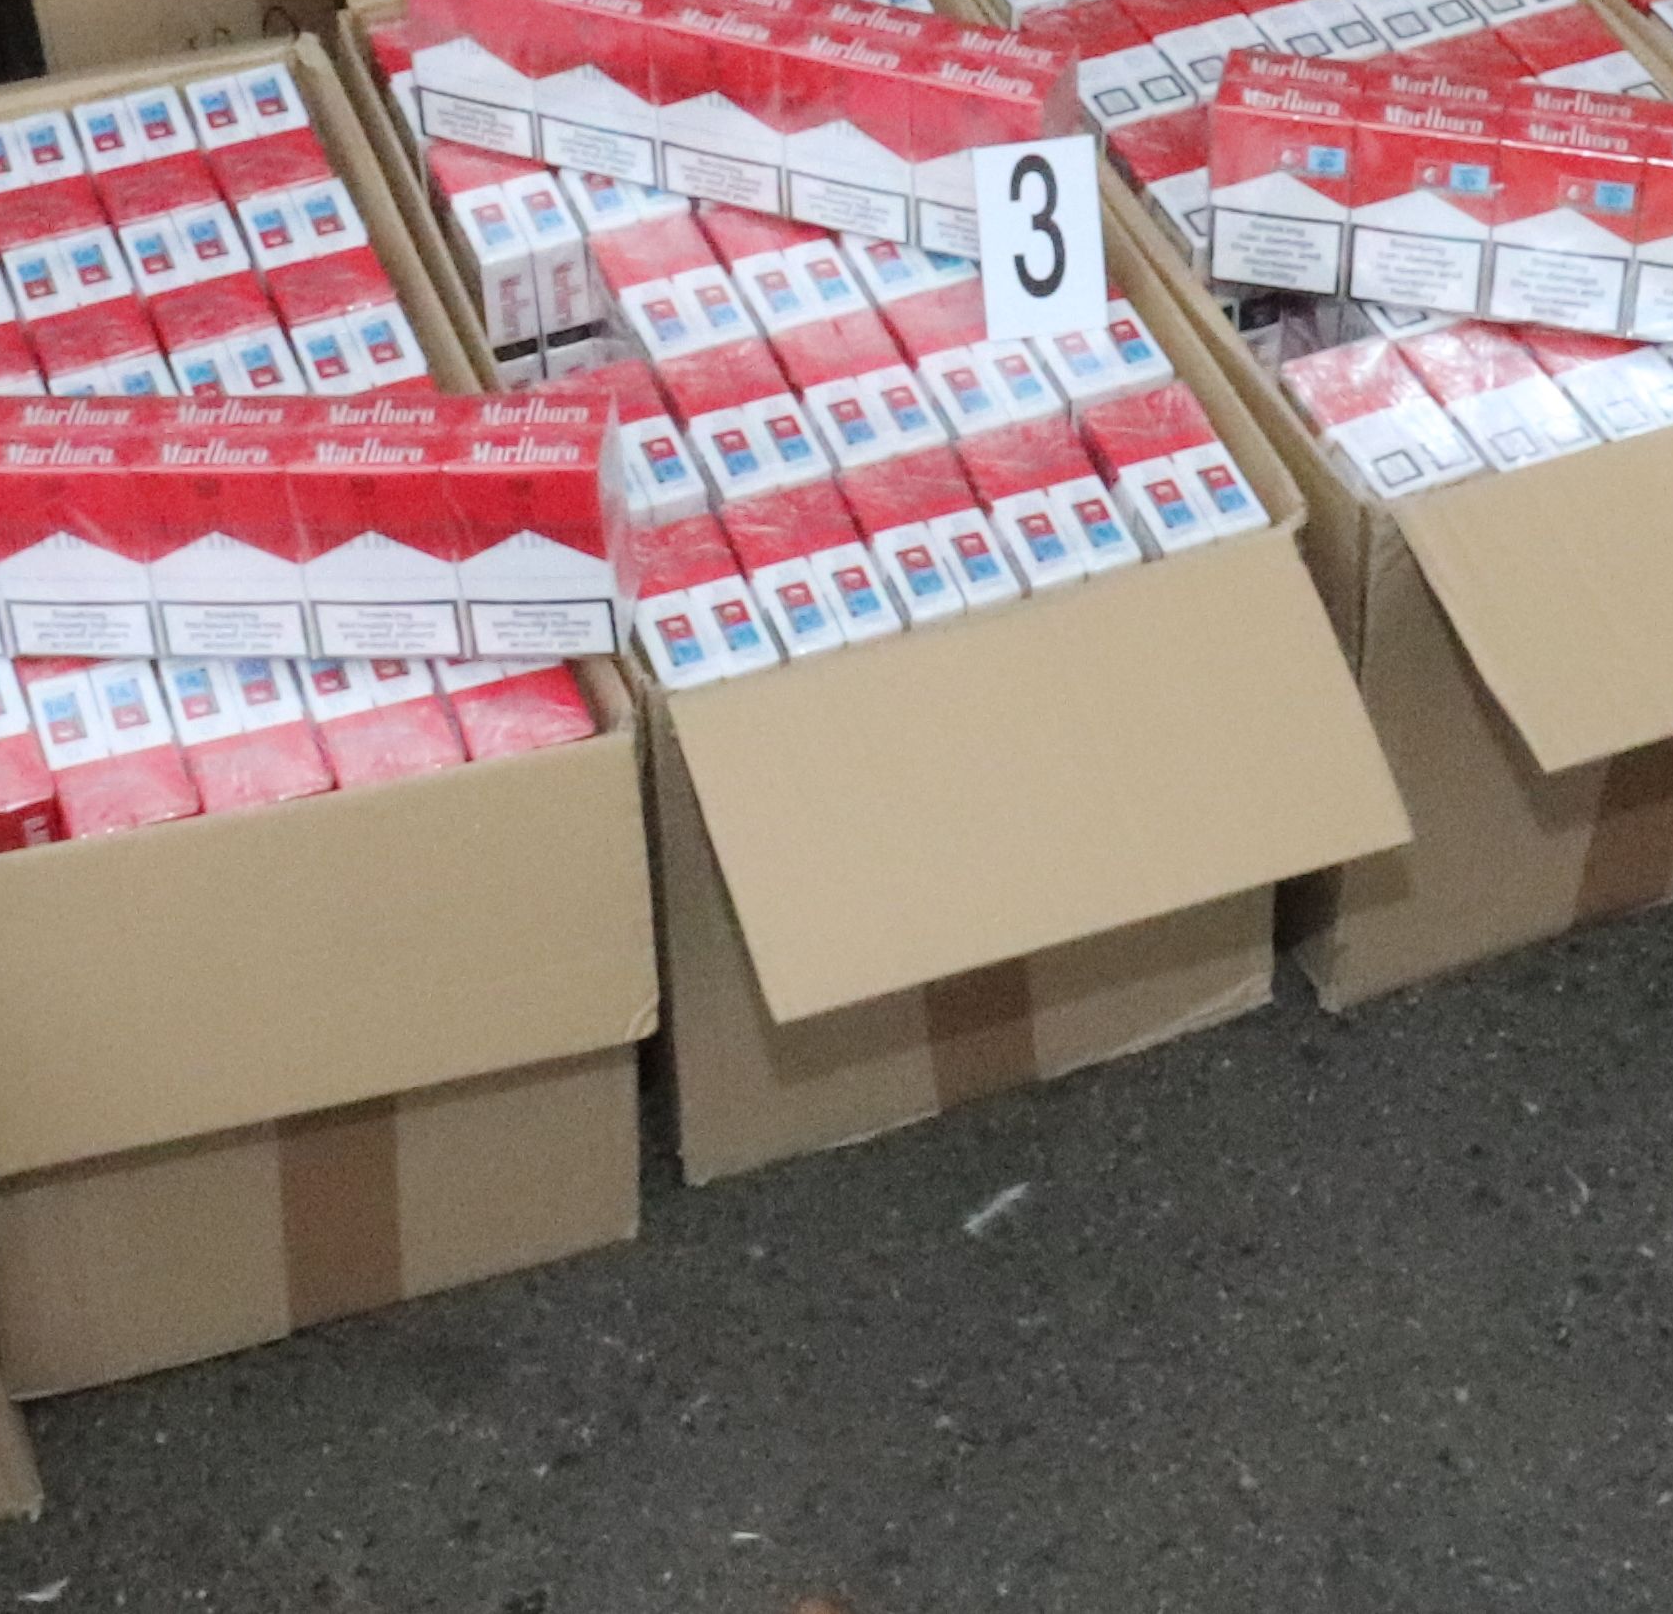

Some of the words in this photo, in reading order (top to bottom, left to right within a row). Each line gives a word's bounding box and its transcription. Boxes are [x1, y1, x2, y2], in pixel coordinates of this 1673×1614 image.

[1250, 57, 1348, 84] Marlboro
[1391, 74, 1489, 101] Marlboro
[1533, 90, 1632, 118] Marlboro
[1243, 88, 1340, 116] Marlboro
[1385, 104, 1484, 134] Marlboro
[1529, 123, 1628, 151] Marlboro
[1010, 155, 1065, 298] 3
[23, 399, 129, 425] Marlboro
[177, 399, 283, 425] Marlboro
[329, 399, 434, 426] Marlboro
[481, 398, 589, 426] Marlboro
[7, 438, 115, 466] Marlboro
[161, 438, 268, 465] Marlboro
[316, 437, 424, 464] Marlboro
[471, 436, 580, 464] Marlboro
